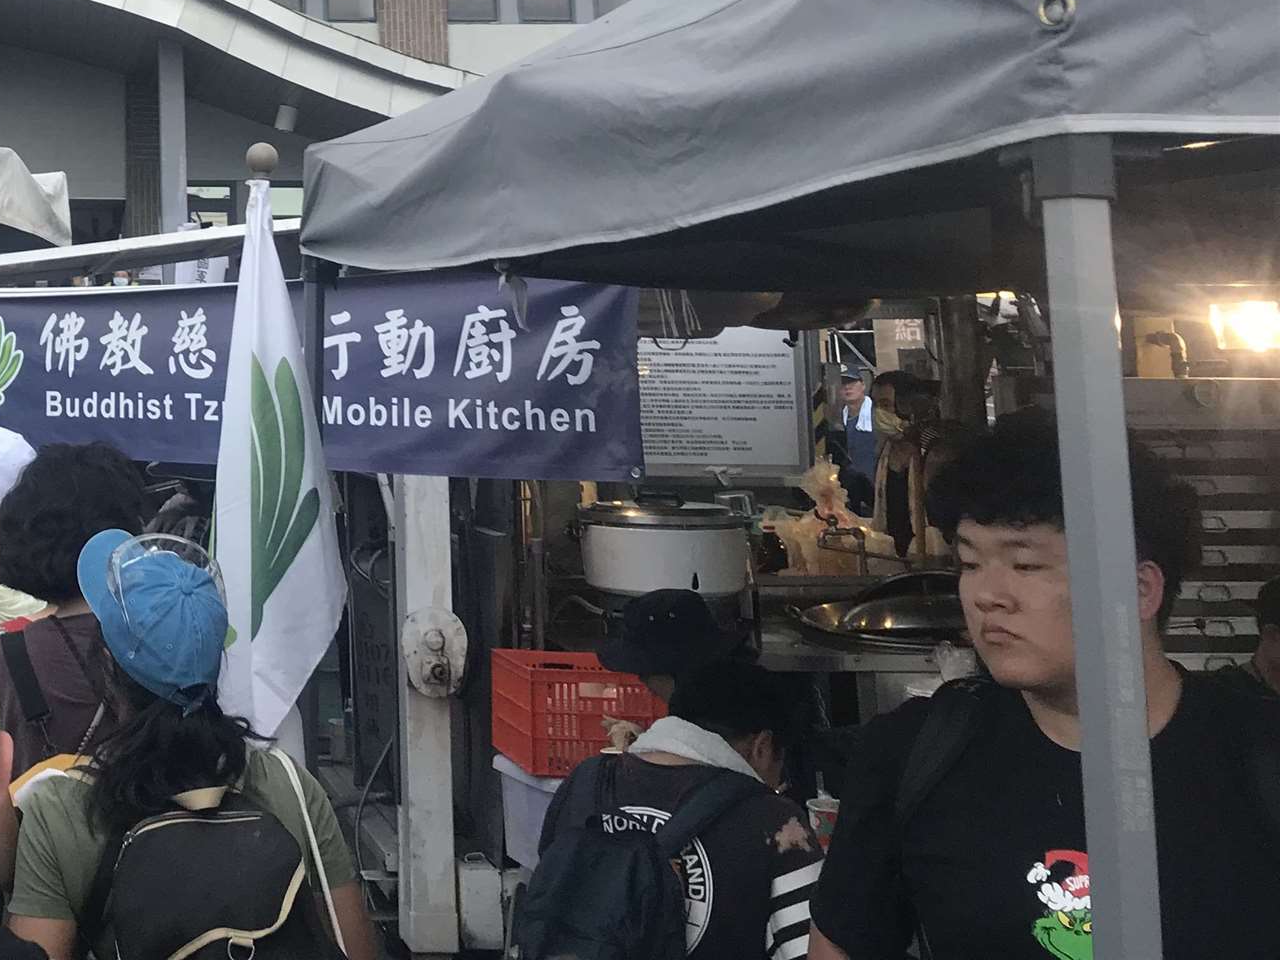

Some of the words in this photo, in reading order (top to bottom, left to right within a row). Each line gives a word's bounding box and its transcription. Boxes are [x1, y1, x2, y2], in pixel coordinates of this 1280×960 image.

[45, 390, 174, 421] Buddhist
[184, 393, 225, 422] Tz
[322, 395, 433, 428] Mobile
[448, 398, 596, 433] Kitchen
